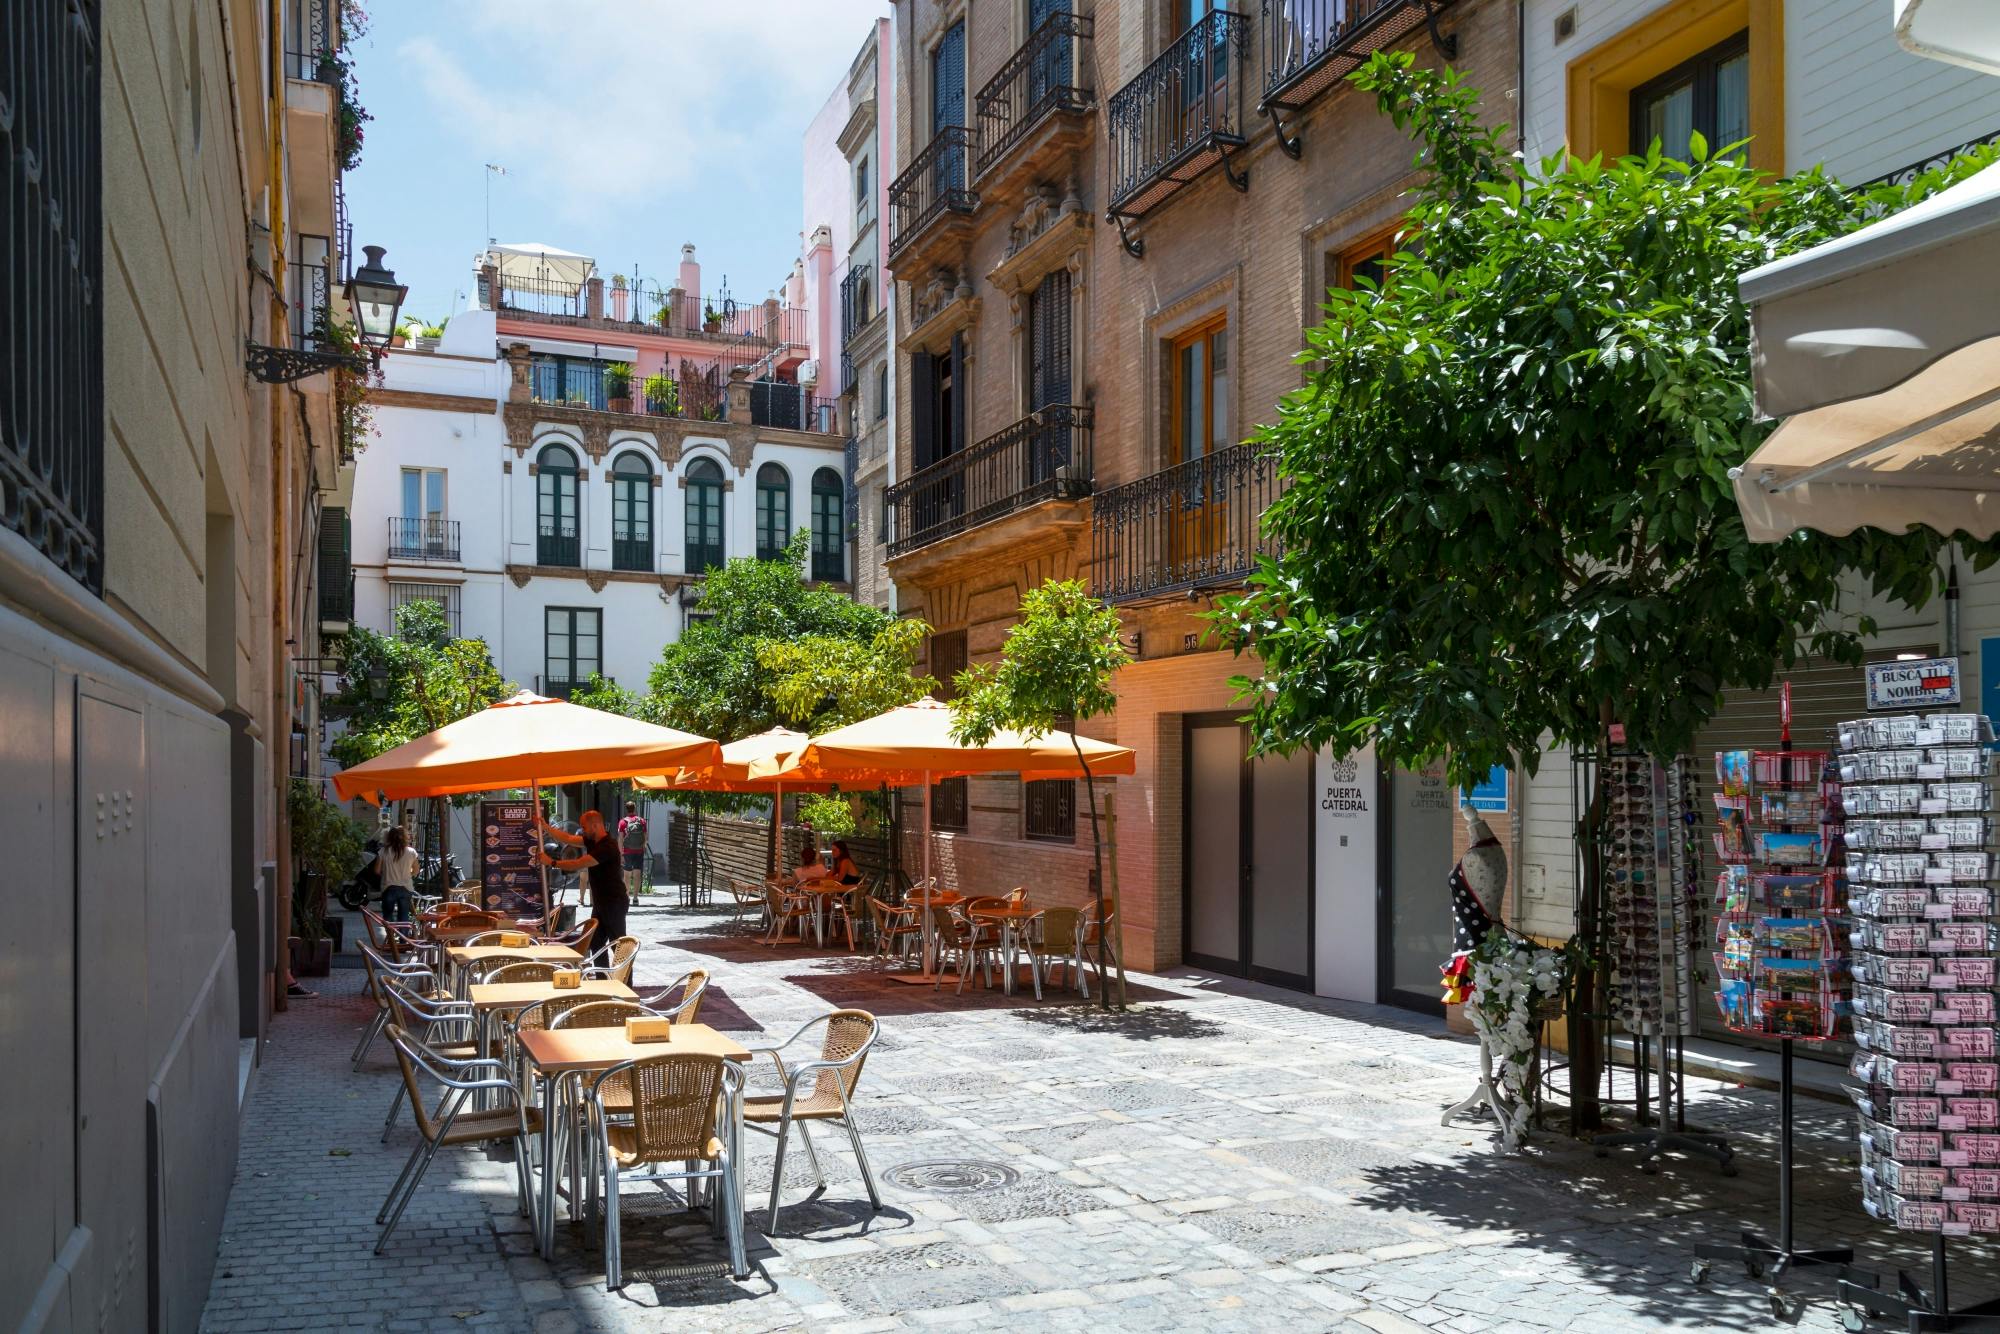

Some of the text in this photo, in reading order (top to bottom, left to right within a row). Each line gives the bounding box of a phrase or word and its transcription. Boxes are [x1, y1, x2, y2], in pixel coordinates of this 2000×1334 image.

[1882, 669, 1922, 683] BUSCA
[1327, 787, 1362, 799] PUERTA
[1416, 789, 1445, 799] PUERTA
[1321, 799, 1369, 811] CATEDRAL
[1410, 799, 1450, 809] CATEDRAL
[1955, 867, 1976, 876] ILAR
[1952, 902, 1978, 911] AQUEL
[1956, 937, 1978, 946] OCIO
[1896, 972, 1923, 981] ROSA
[1960, 1007, 1985, 1016] AMUEL
[1964, 1043, 1985, 1052] ARA
[1966, 1112, 1988, 1121] OMAS
[1967, 1148, 1996, 1157] ANESSA
